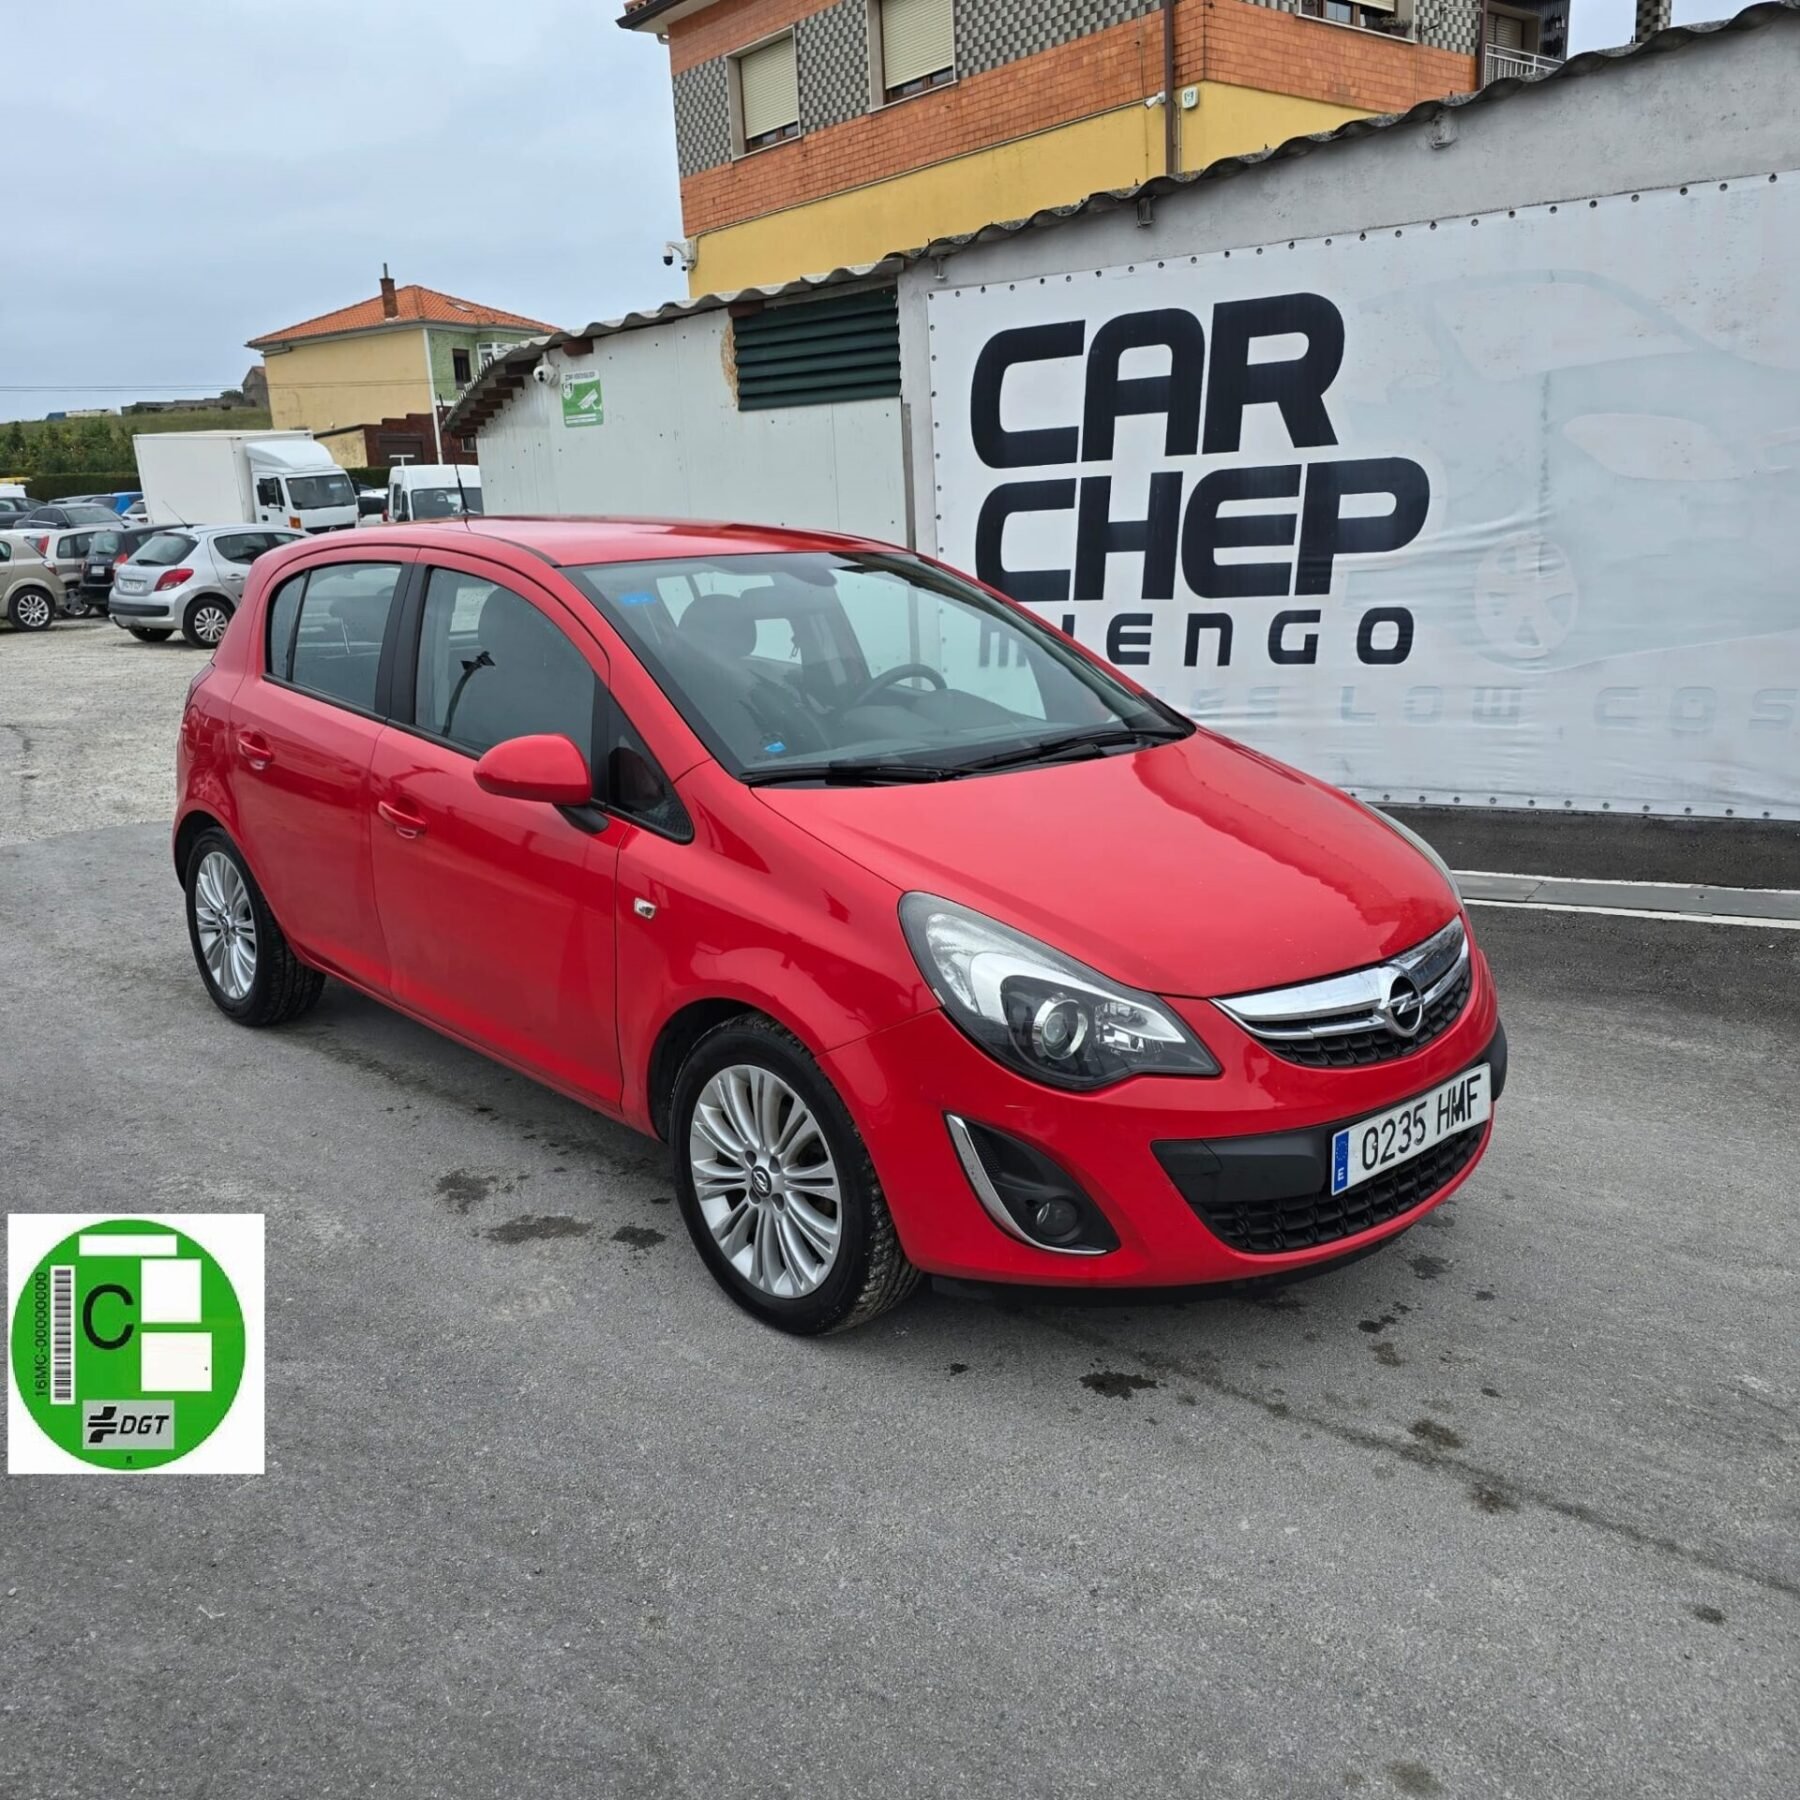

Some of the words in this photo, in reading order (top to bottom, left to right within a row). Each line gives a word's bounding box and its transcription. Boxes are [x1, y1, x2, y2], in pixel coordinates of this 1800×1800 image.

[971, 292, 1345, 469] CAR
[975, 457, 1430, 601] CHEP
[1340, 686, 1522, 727] LOW
[1337, 1166, 1345, 1181] E
[1362, 1101, 1428, 1171] 0235
[1437, 1073, 1481, 1135] HMF
